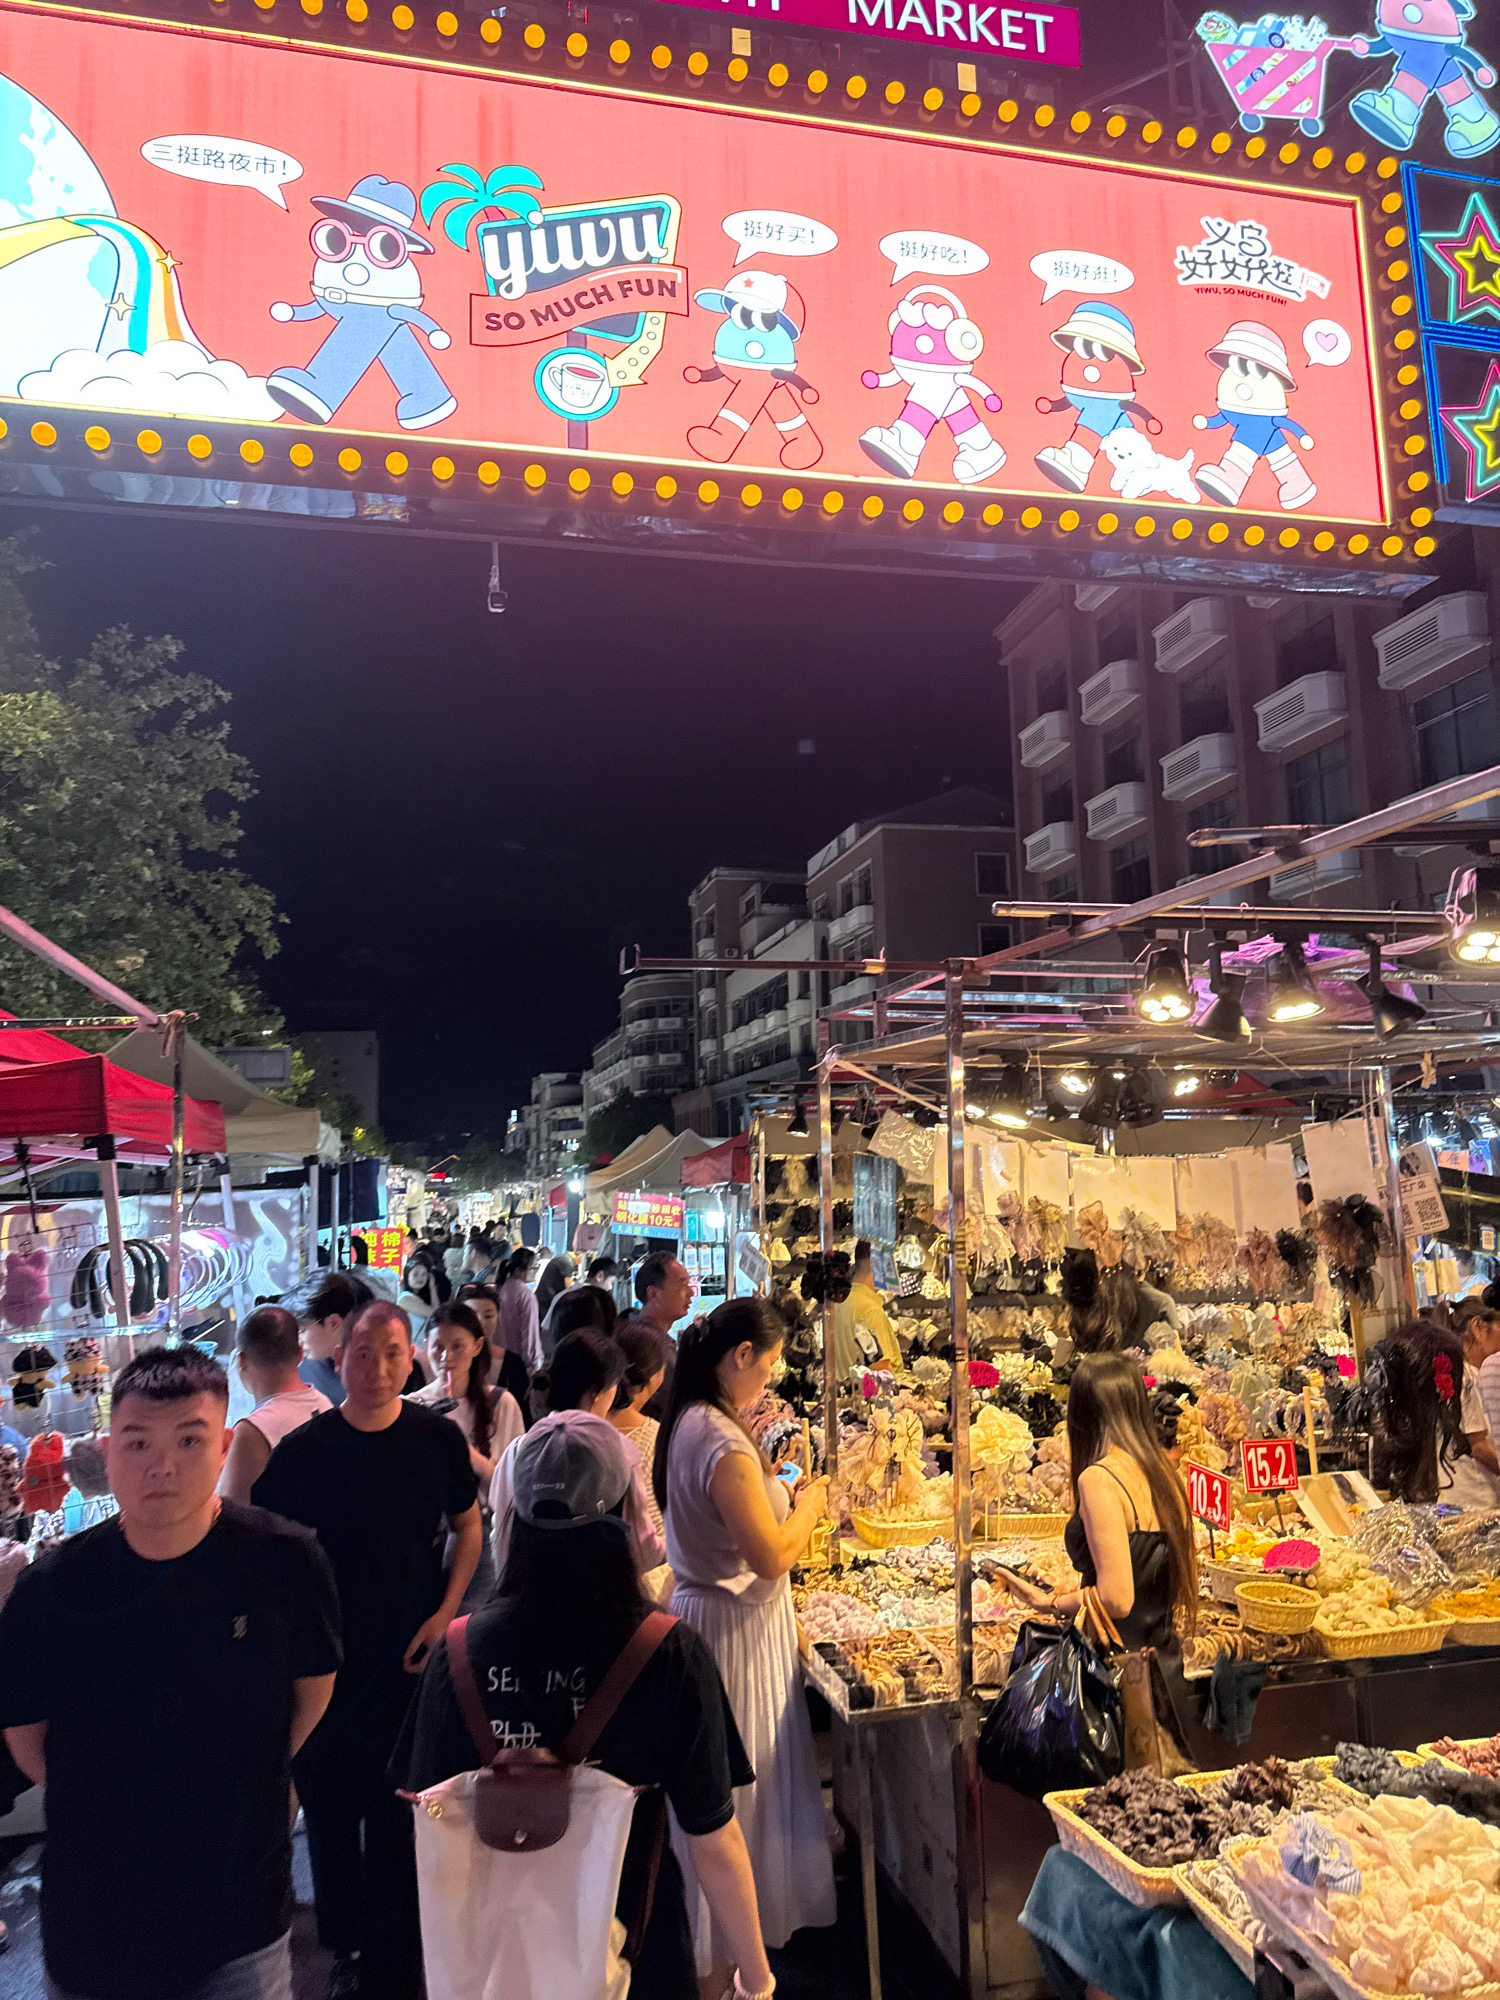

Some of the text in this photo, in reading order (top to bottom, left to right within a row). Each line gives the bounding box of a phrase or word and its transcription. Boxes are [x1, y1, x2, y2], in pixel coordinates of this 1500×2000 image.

[847, 0, 1053, 53] MARKET
[151, 143, 287, 176] 三挺路夜市!
[744, 219, 815, 245] 挺好买!
[900, 240, 967, 264] 挺好吃!
[1053, 260, 1117, 283] 挺好逛!
[485, 277, 677, 331] SO MUCH FUN
[1223, 287, 1236, 295] SO
[1237, 289, 1265, 301] MUCH
